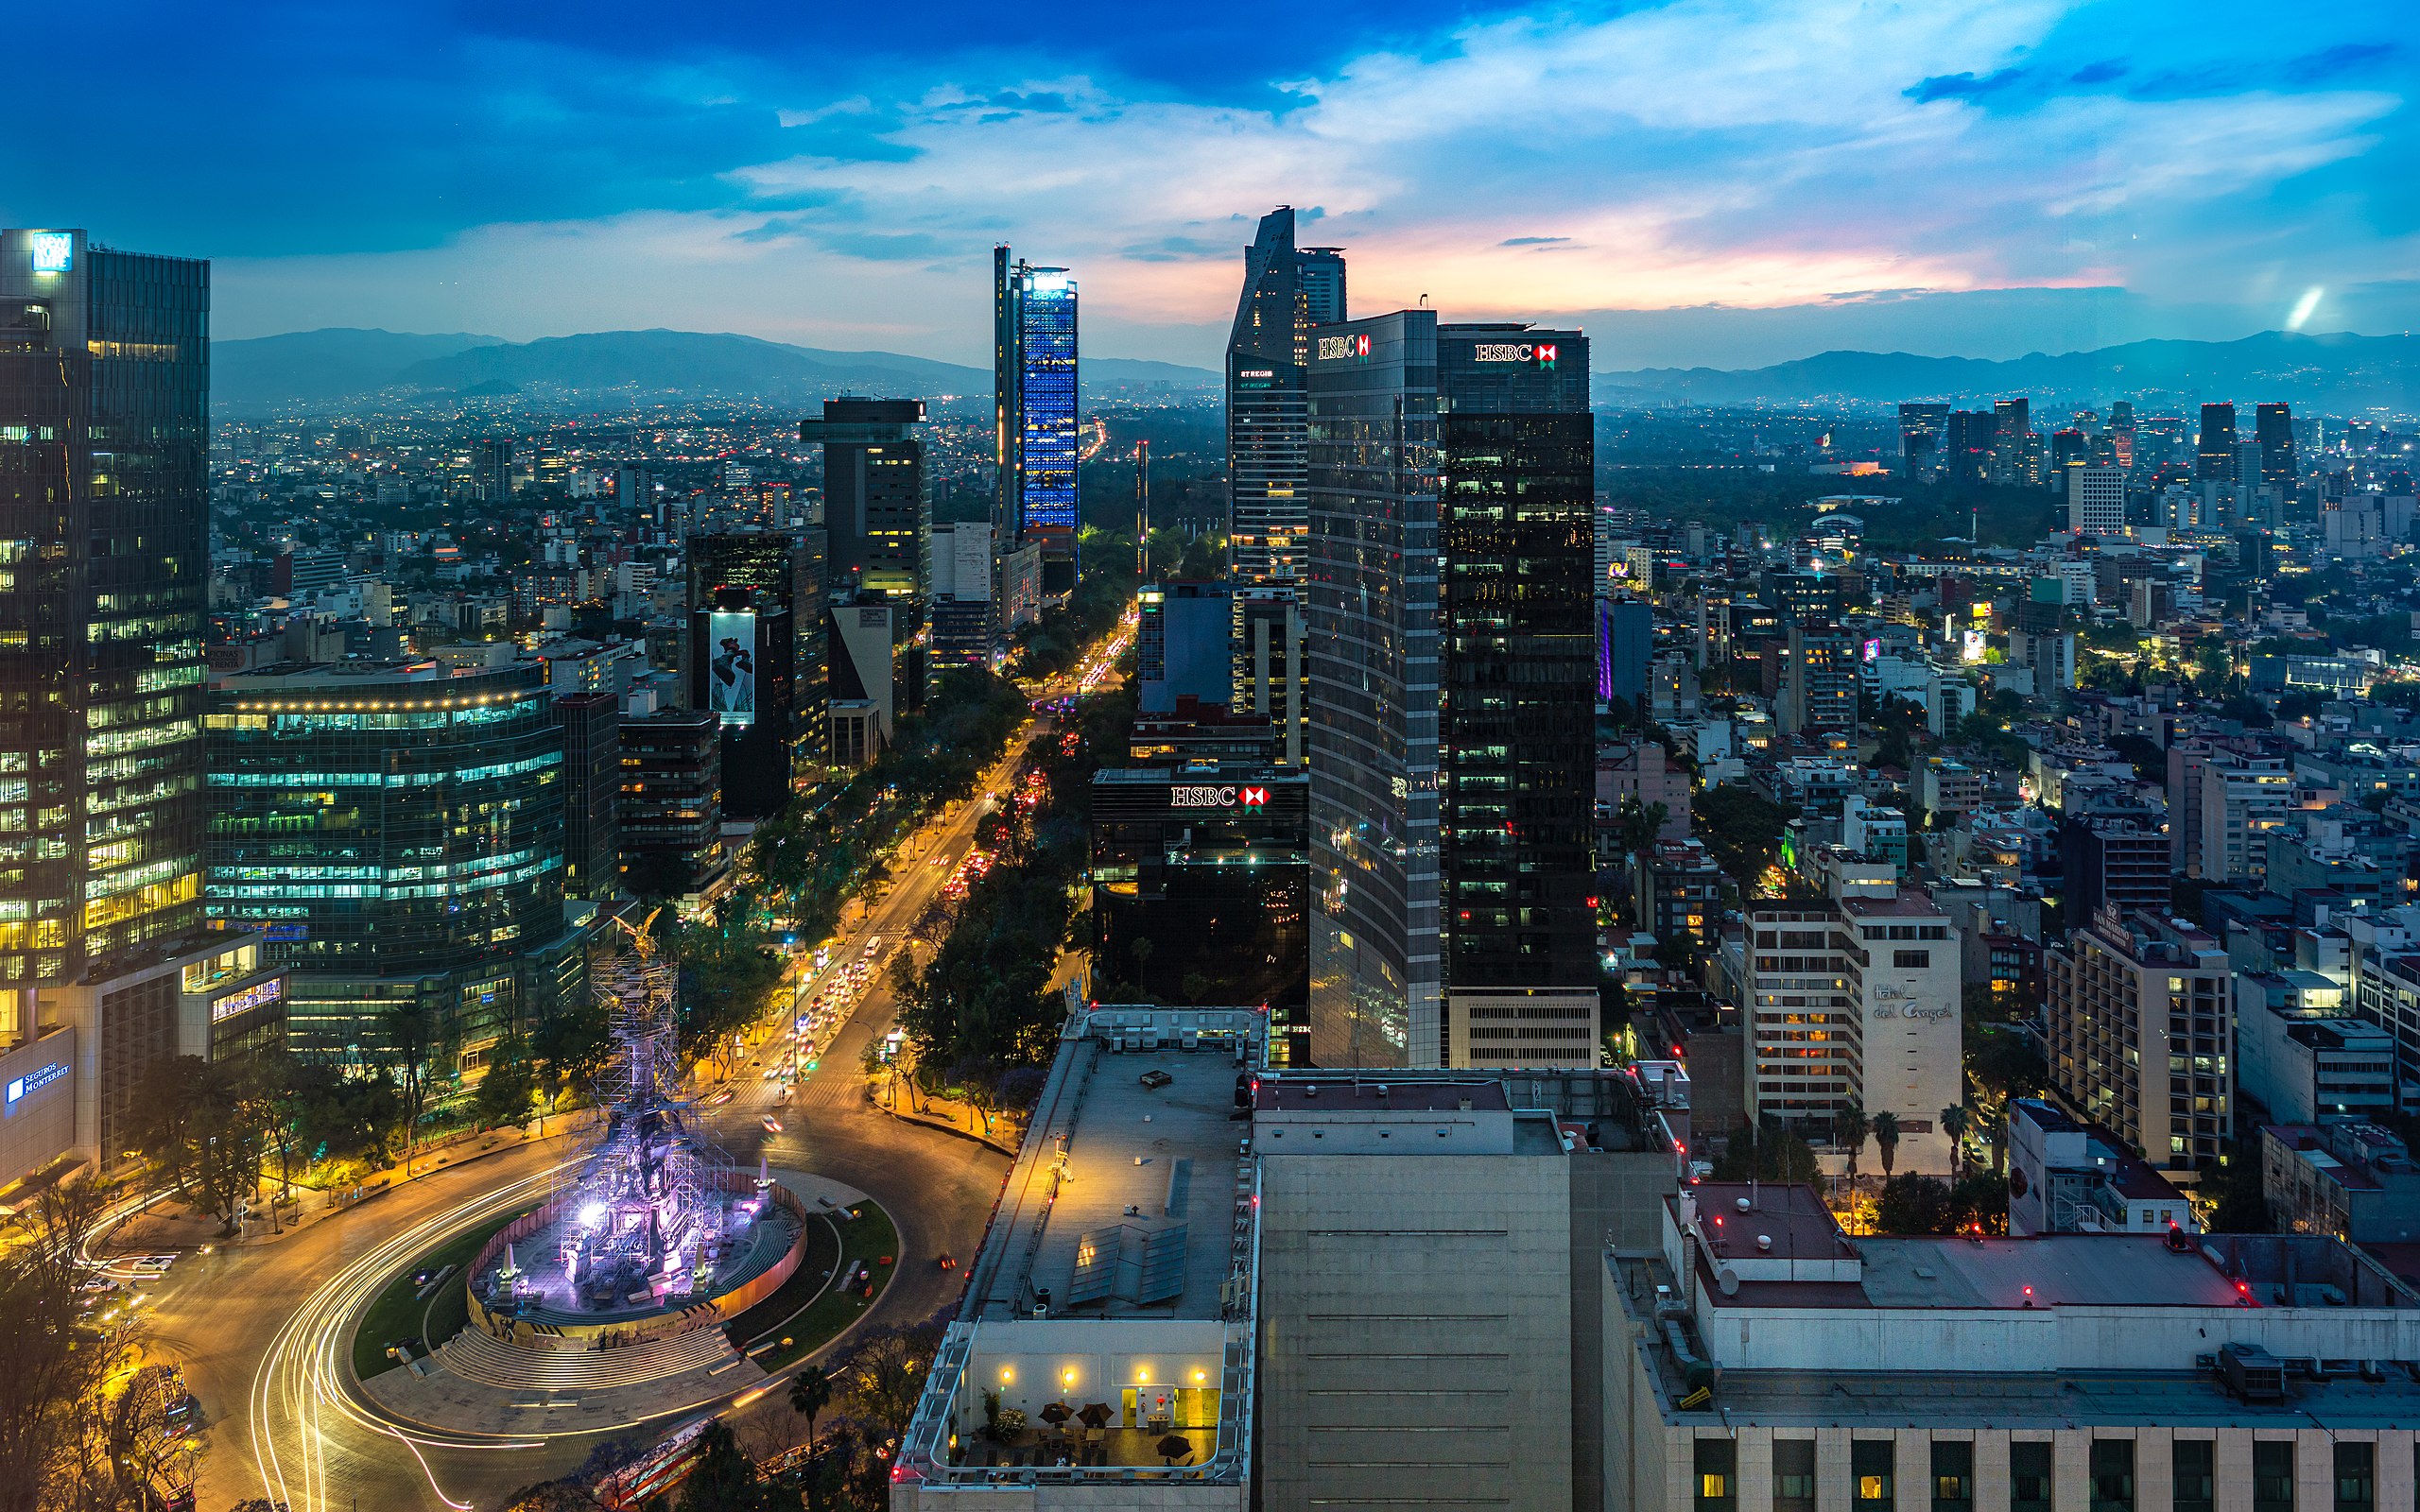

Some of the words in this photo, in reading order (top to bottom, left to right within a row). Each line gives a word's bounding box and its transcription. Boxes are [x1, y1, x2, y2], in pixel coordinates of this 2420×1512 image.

[39, 236, 68, 247] NEW
[37, 246, 70, 257] YORK
[40, 257, 67, 267] LIFE
[1033, 291, 1065, 300] BBVA
[1318, 335, 1355, 360] HSBC
[1475, 344, 1531, 362] HSBC
[1170, 786, 1236, 806] HSBC
[2093, 912, 2105, 926] SAN
[2105, 919, 2130, 940] MARINO
[1874, 1004, 1897, 1018] del
[25, 1062, 57, 1084] SEGUROS
[25, 1065, 70, 1094] MONTERREY
